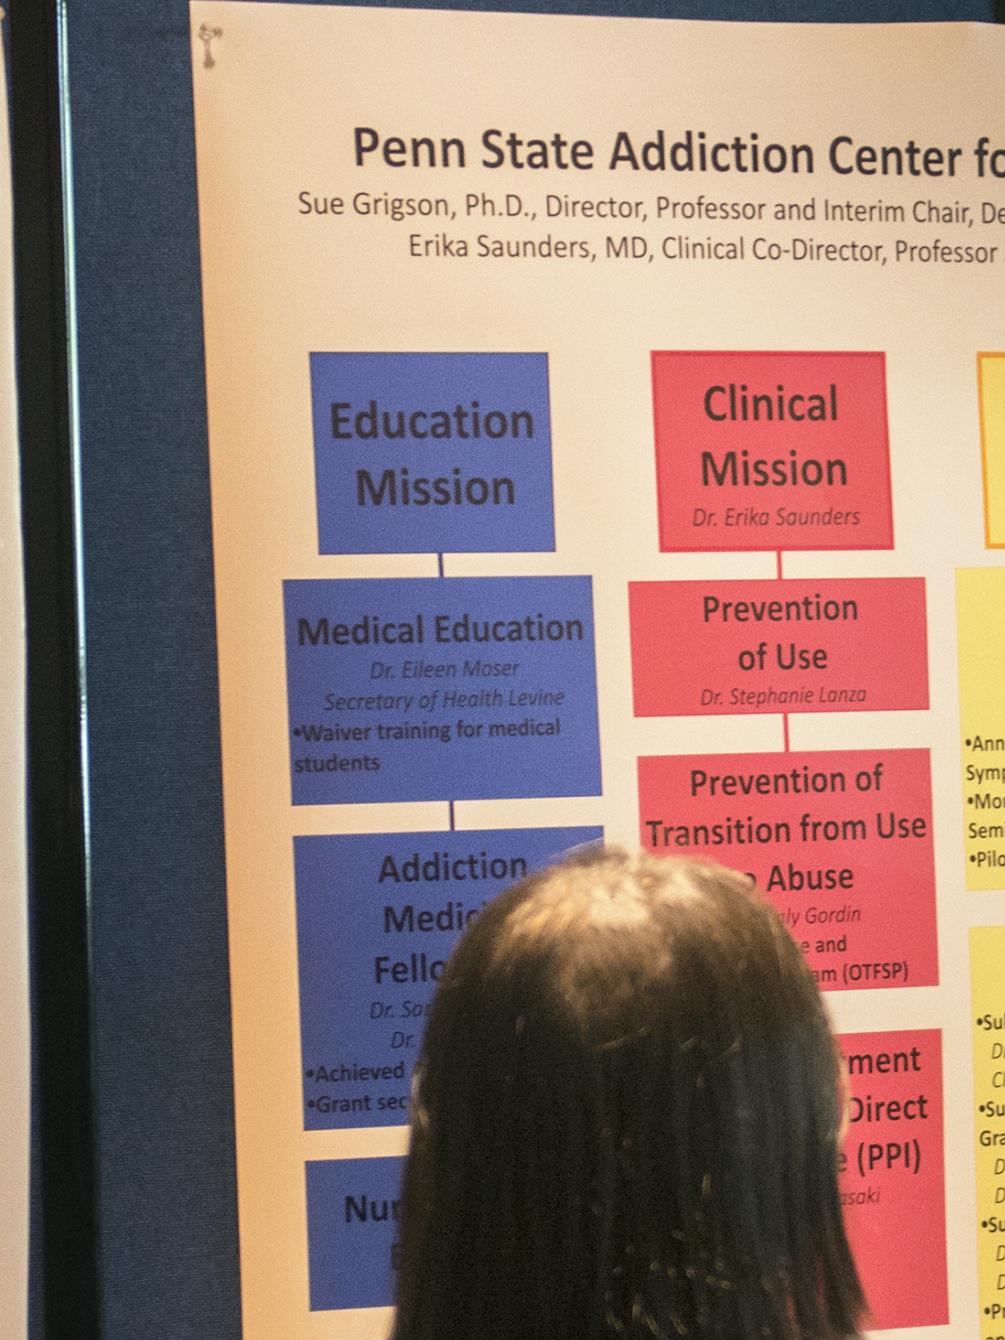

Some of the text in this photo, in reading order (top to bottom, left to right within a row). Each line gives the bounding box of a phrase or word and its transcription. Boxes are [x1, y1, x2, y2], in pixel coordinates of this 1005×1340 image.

[354, 126, 466, 168] Penn
[481, 128, 594, 171] State
[609, 129, 814, 174] Addiction
[828, 135, 963, 178] Center
[299, 191, 344, 215] Sue
[352, 191, 457, 222] Grigson,
[465, 192, 537, 221] Ph.D.,
[545, 194, 648, 223] Director,
[656, 194, 767, 221] Professor
[774, 198, 815, 221] and
[824, 198, 906, 223] Interim
[912, 199, 974, 228] Chair,
[410, 233, 468, 257] Erika
[476, 233, 597, 263] Saunders,
[605, 235, 654, 263] MD,
[662, 236, 744, 260] Clinical
[752, 237, 888, 266] Co-Director,
[896, 239, 998, 263] Professor
[703, 383, 838, 422] Clinical
[329, 399, 534, 441] Education
[700, 449, 848, 487] Mission
[355, 466, 515, 507] Mission
[693, 506, 860, 527] Dr. Erika Saunders
[703, 592, 858, 623] Prevention
[296, 612, 584, 647] Medical Education
[370, 659, 520, 679] Dr. Eileen Moser
[738, 641, 827, 672] of Use
[701, 687, 867, 708] Dr. Stephanie Lanza
[303, 718, 560, 743] Waiver training for medical
[294, 753, 380, 774] students
[690, 762, 884, 797] Prevention of
[645, 812, 926, 848] Transition from Use
[377, 851, 527, 884] Addiction
[766, 862, 854, 892] Abuse
[805, 905, 861, 924] Gordin
[843, 961, 908, 984] (OTFSP)
[315, 1061, 404, 1083] Achieved
[850, 1094, 929, 1123] Direct
[857, 1138, 922, 1178] (PPI)
